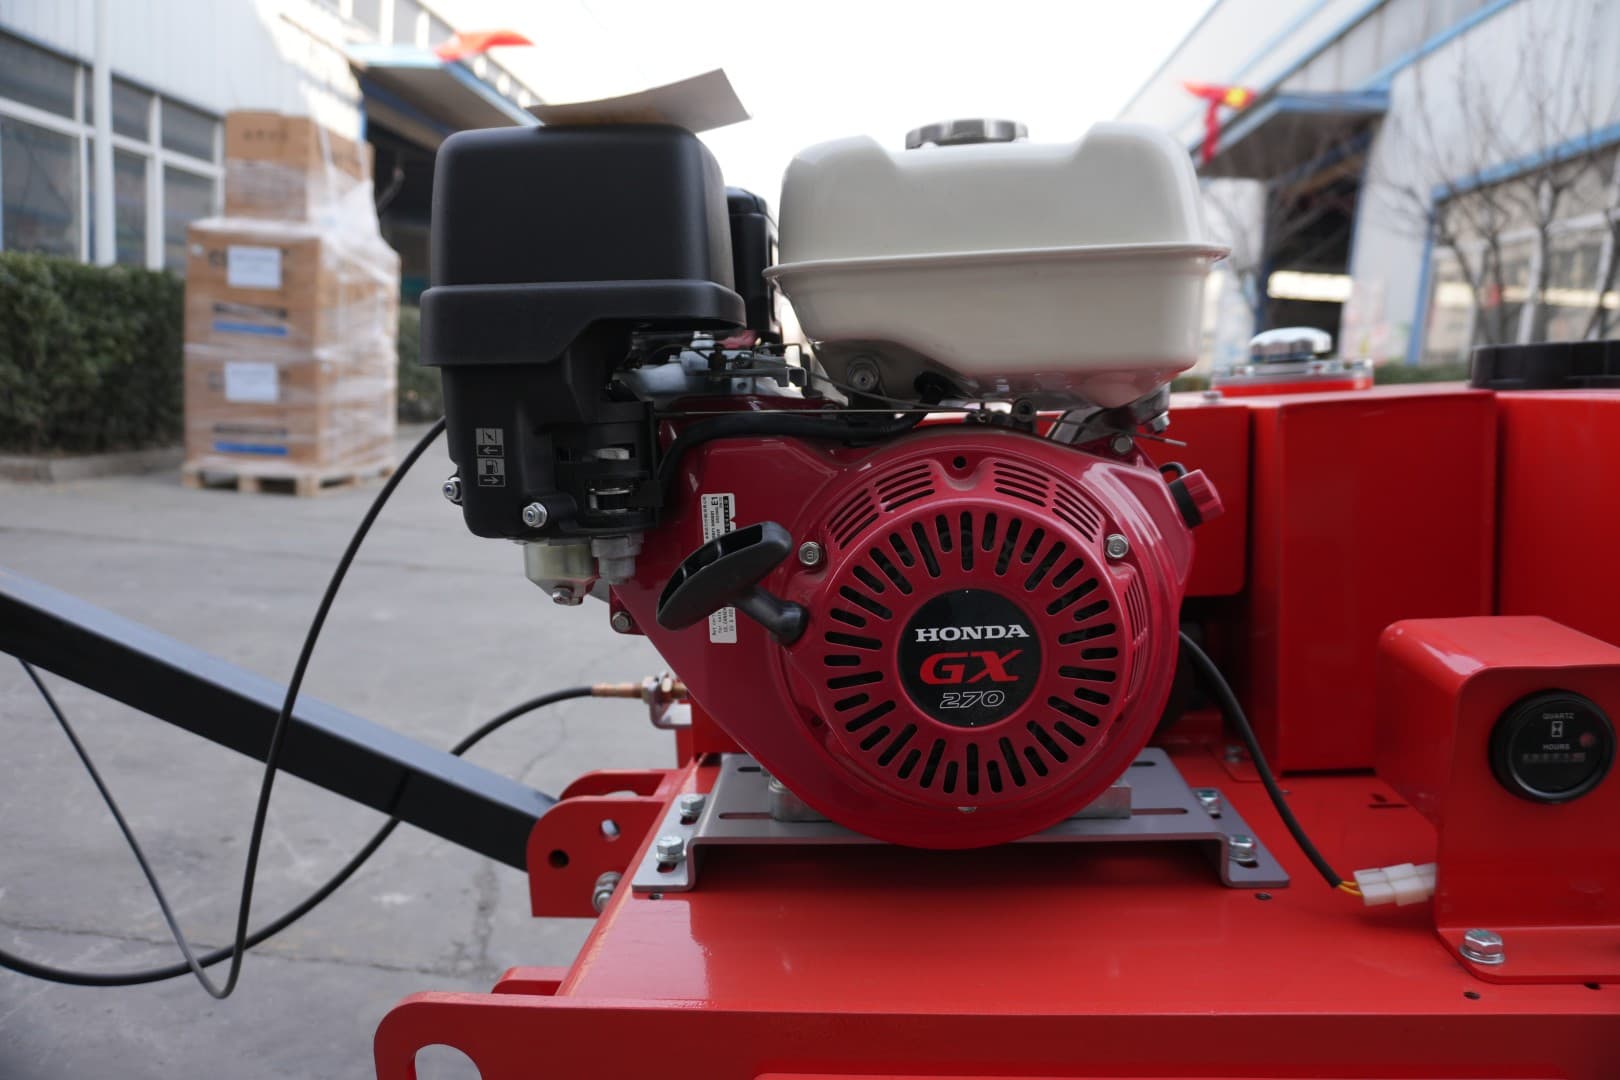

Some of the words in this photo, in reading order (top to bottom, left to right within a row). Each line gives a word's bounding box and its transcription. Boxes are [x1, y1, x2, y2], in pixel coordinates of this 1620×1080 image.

[914, 624, 1030, 642] HONDA
[919, 649, 1023, 685] GX
[939, 690, 1005, 709] 270
[1543, 712, 1575, 720] QUARTZ
